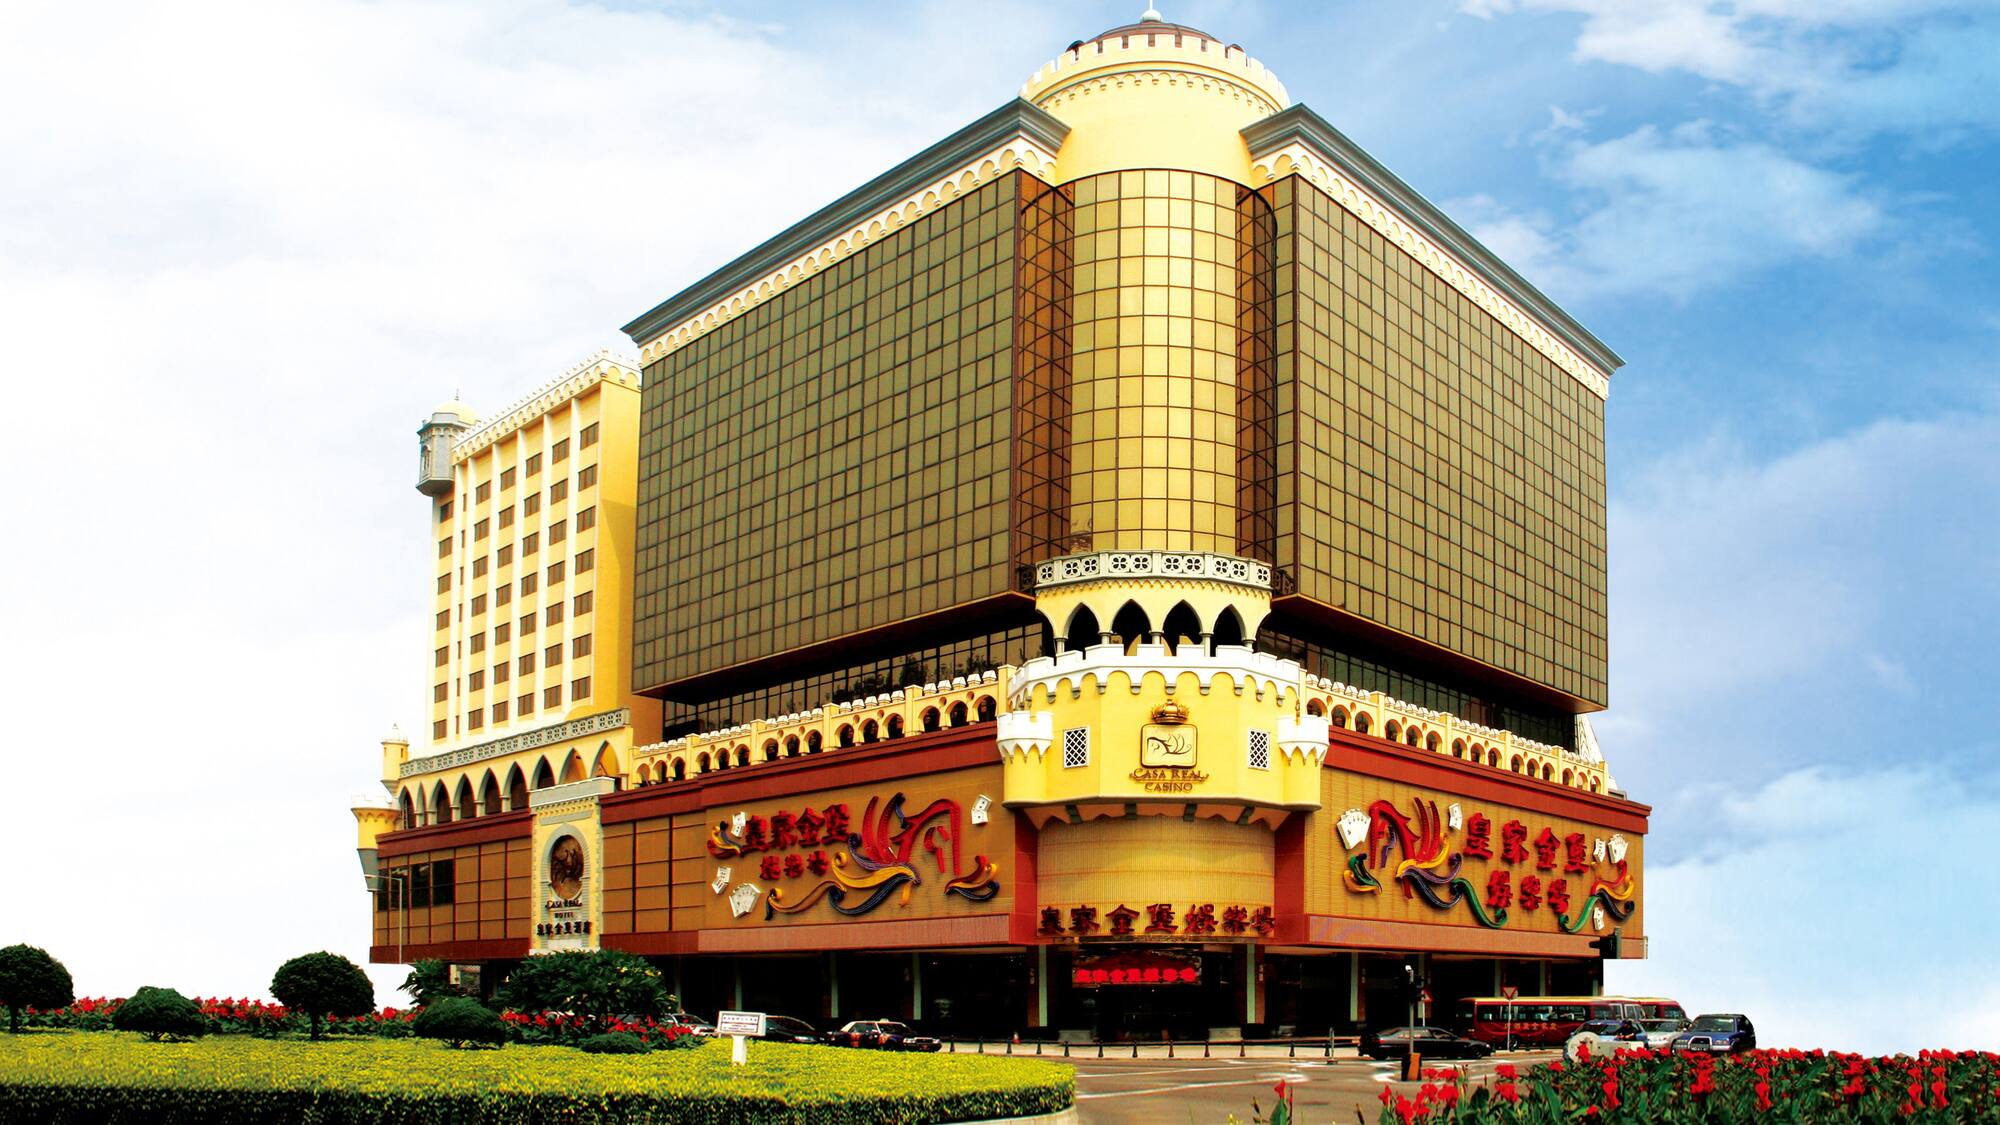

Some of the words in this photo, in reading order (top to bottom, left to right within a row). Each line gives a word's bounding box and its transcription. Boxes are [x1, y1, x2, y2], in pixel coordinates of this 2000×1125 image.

[1145, 782, 1193, 792] CASINO
[1463, 812, 1590, 874] 皇家金堡
